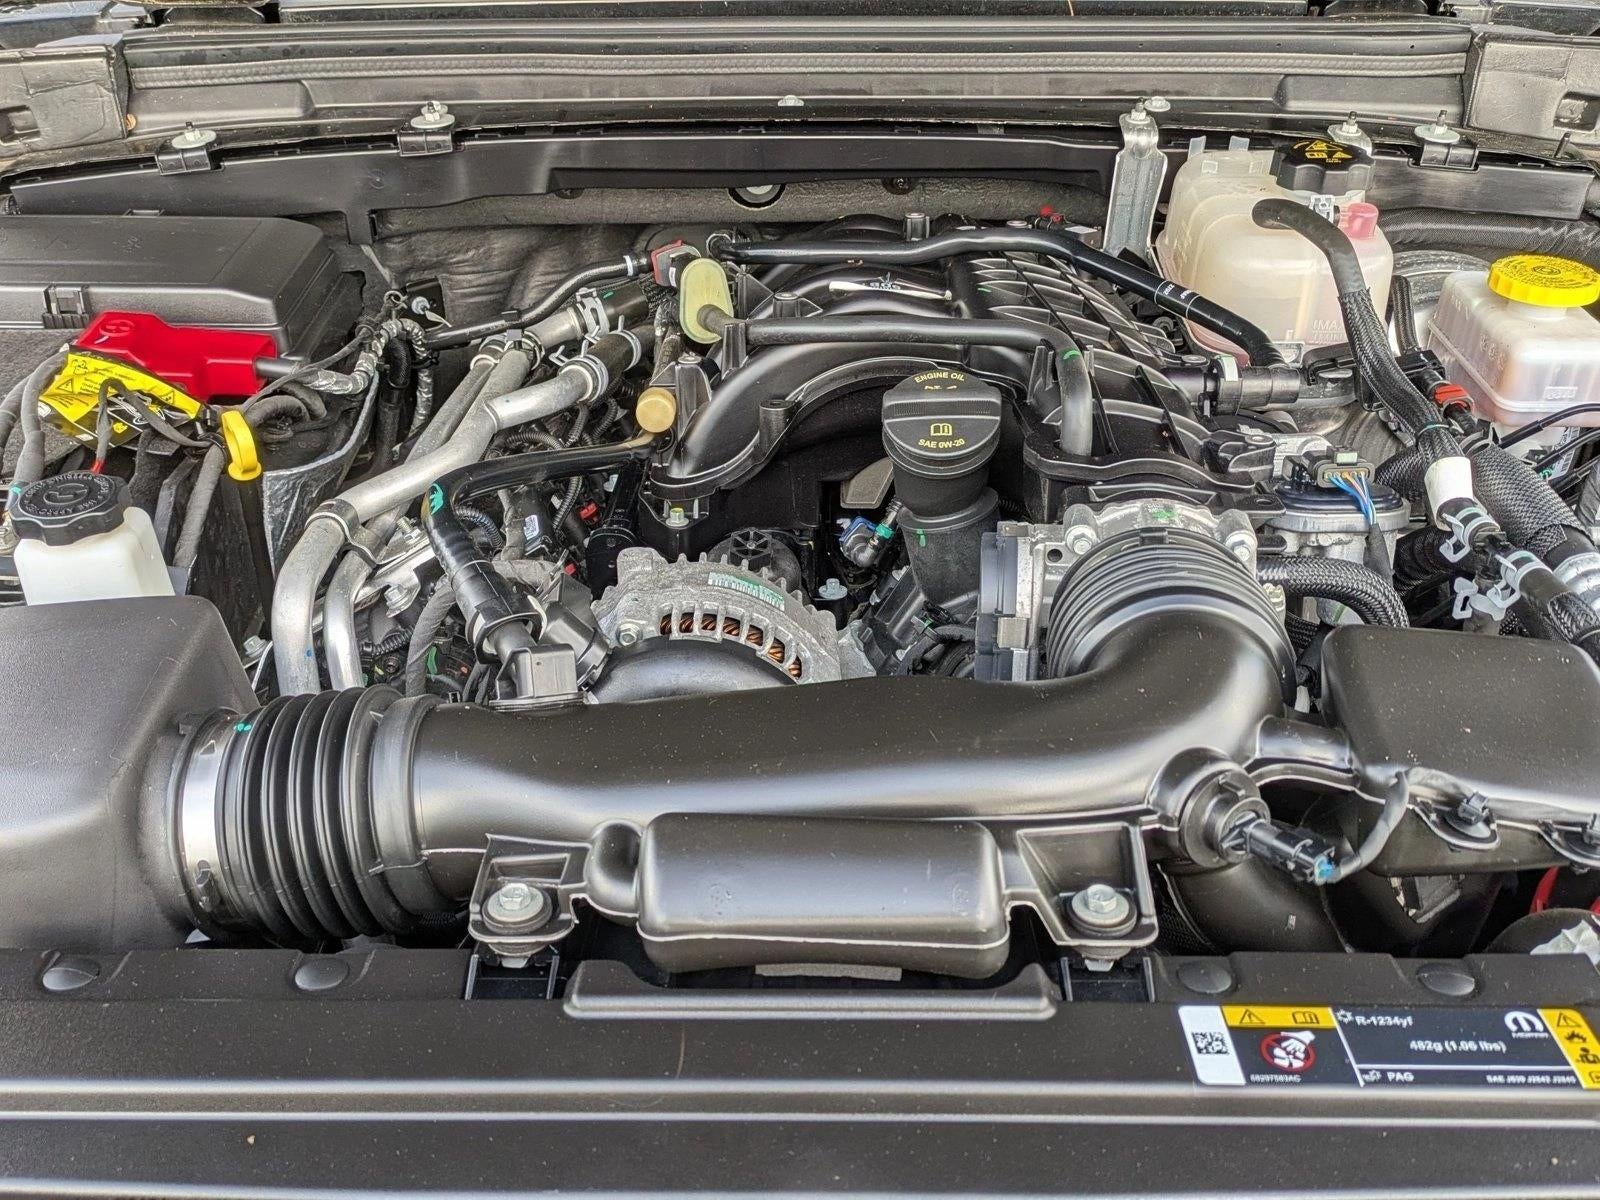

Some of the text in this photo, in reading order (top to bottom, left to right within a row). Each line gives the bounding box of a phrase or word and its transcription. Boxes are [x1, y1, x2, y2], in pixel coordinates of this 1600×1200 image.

[914, 371, 965, 383] ENGINE OIL
[918, 438, 965, 448] SAE 0W-20
[1355, 1015, 1413, 1028] R-1234yf
[1478, 1040, 1507, 1054] lbs)
[1386, 1071, 1415, 1082] PAG
